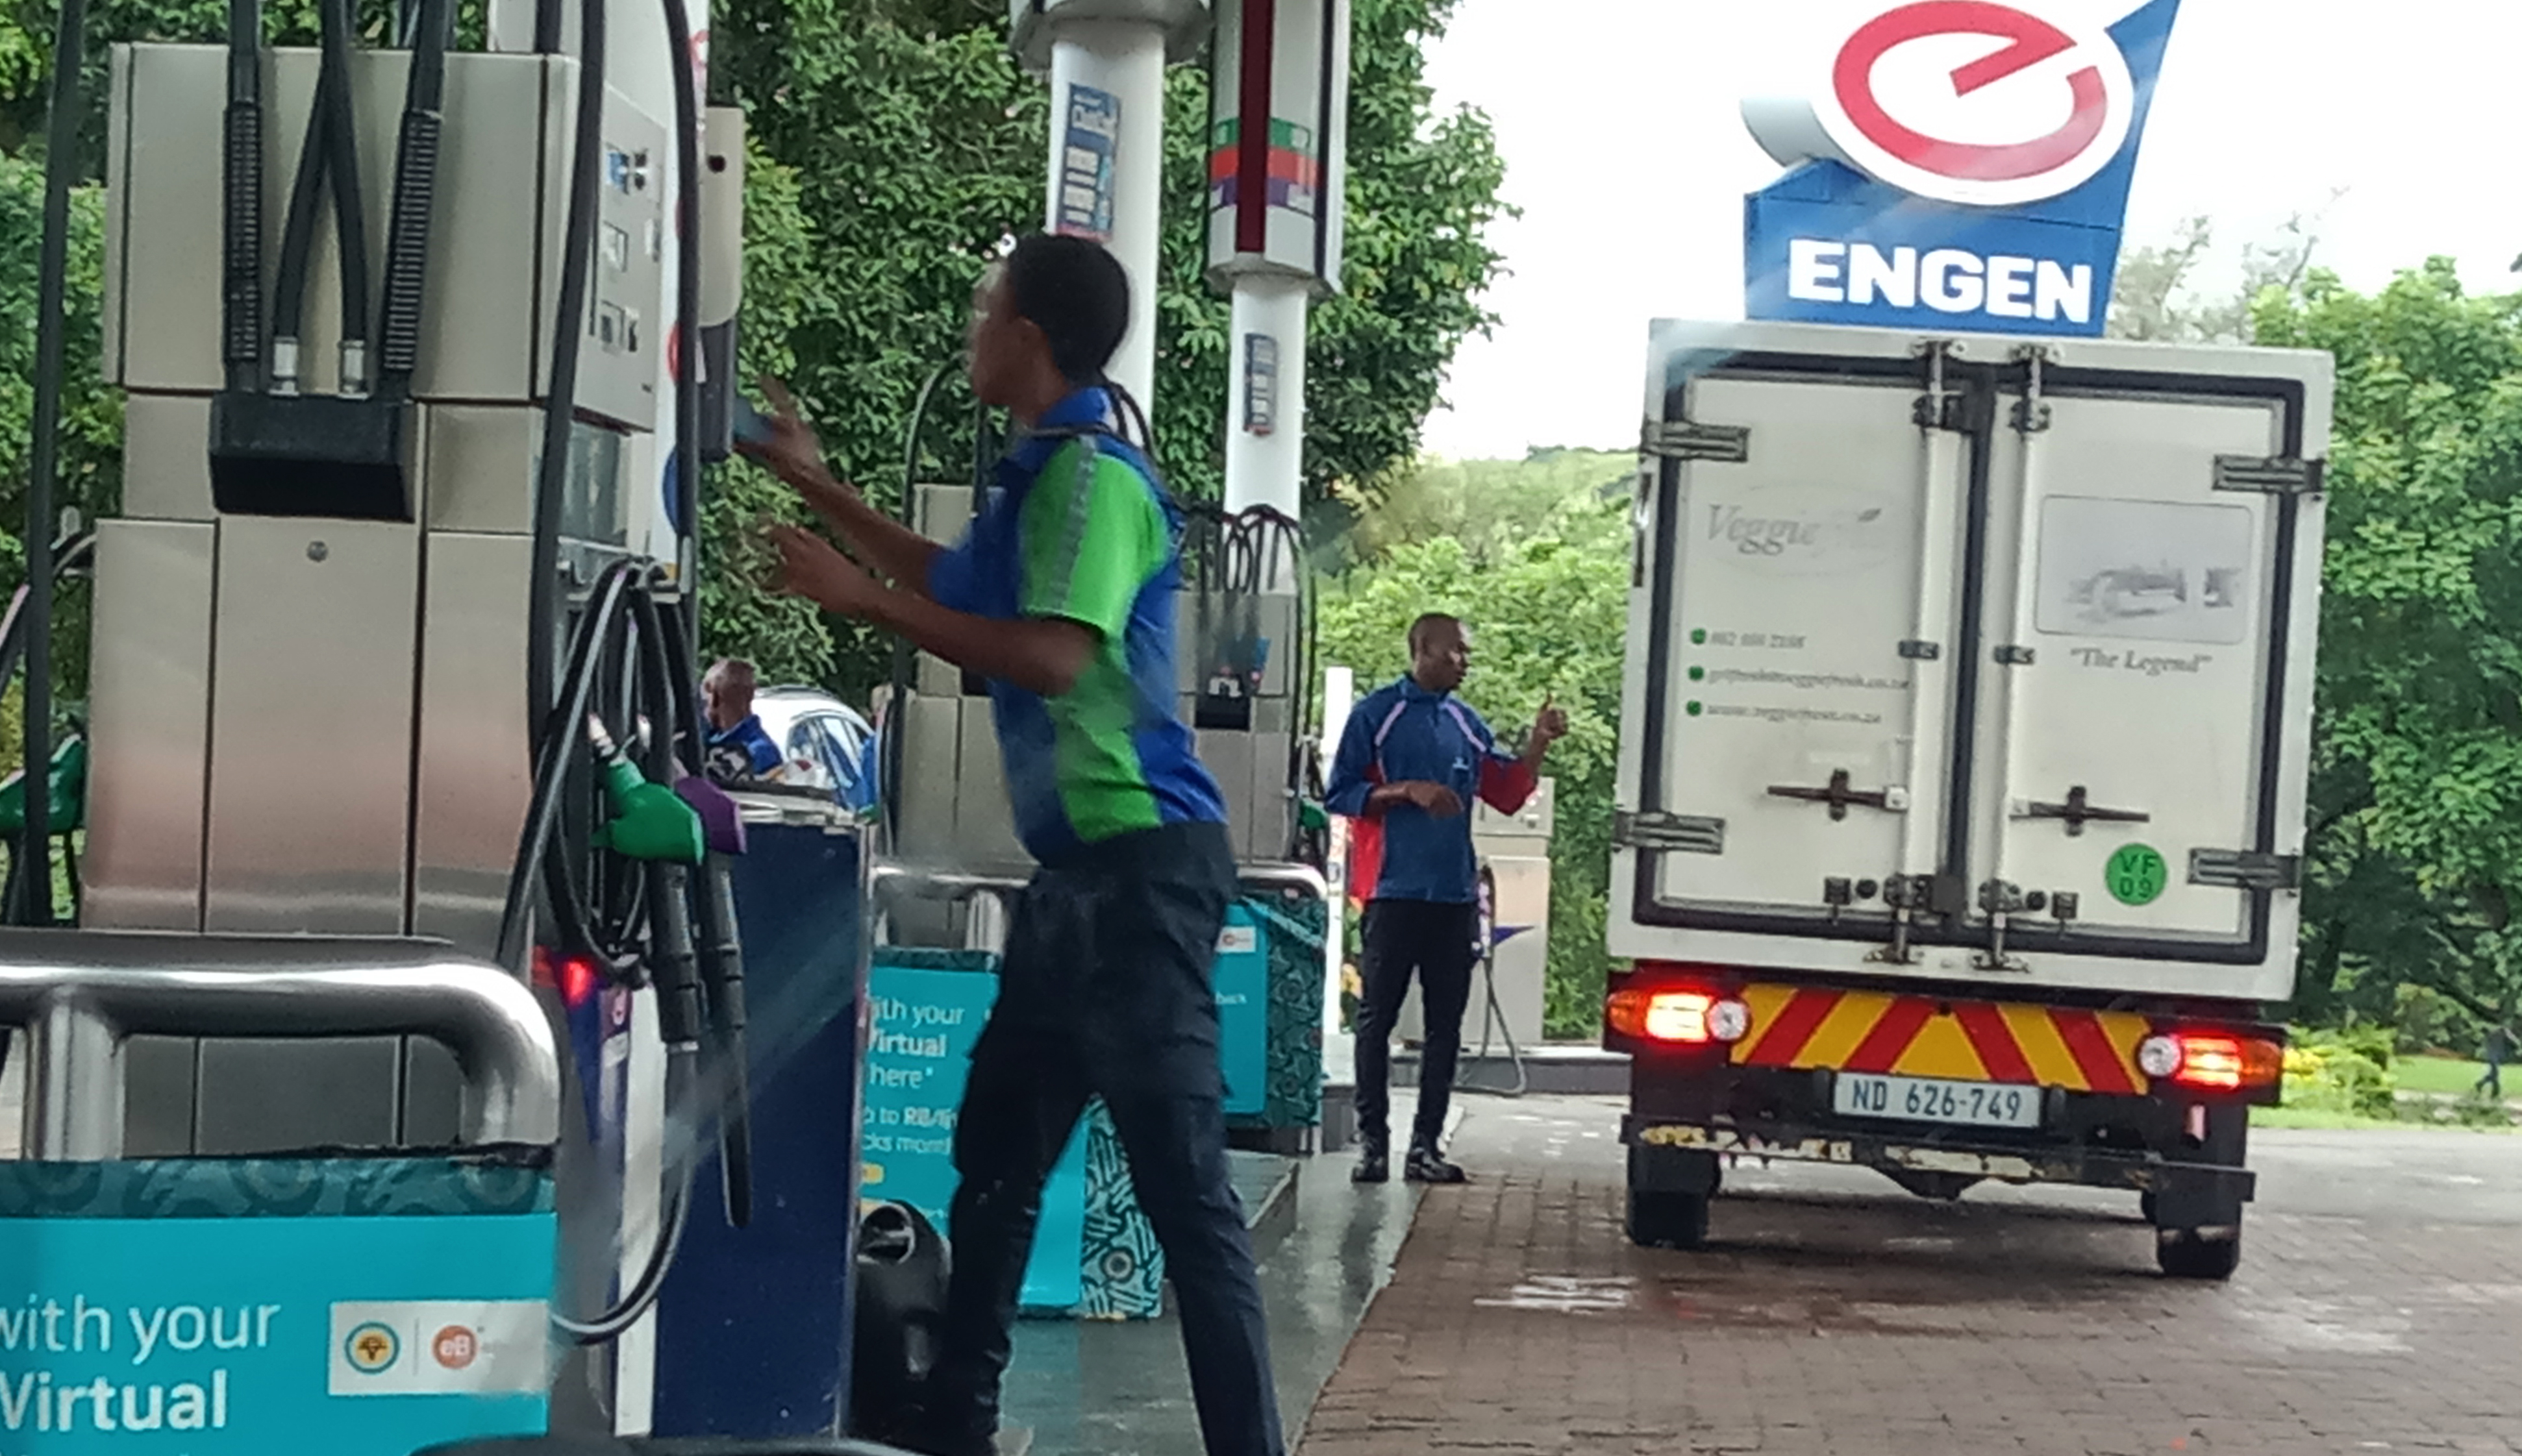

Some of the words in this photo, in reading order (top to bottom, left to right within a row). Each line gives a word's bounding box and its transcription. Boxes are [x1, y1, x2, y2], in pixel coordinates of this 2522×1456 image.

[1788, 238, 2092, 323] ENGEN
[1708, 503, 1821, 556] Veggie
[2117, 852, 2160, 876] VF
[2119, 876, 2153, 898] 09
[912, 1006, 965, 1029] your
[1853, 1079, 1888, 1112] ND
[1906, 1083, 2021, 1120] 626-749
[129, 1305, 282, 1365] your
[0, 1368, 229, 1431] Virtual
